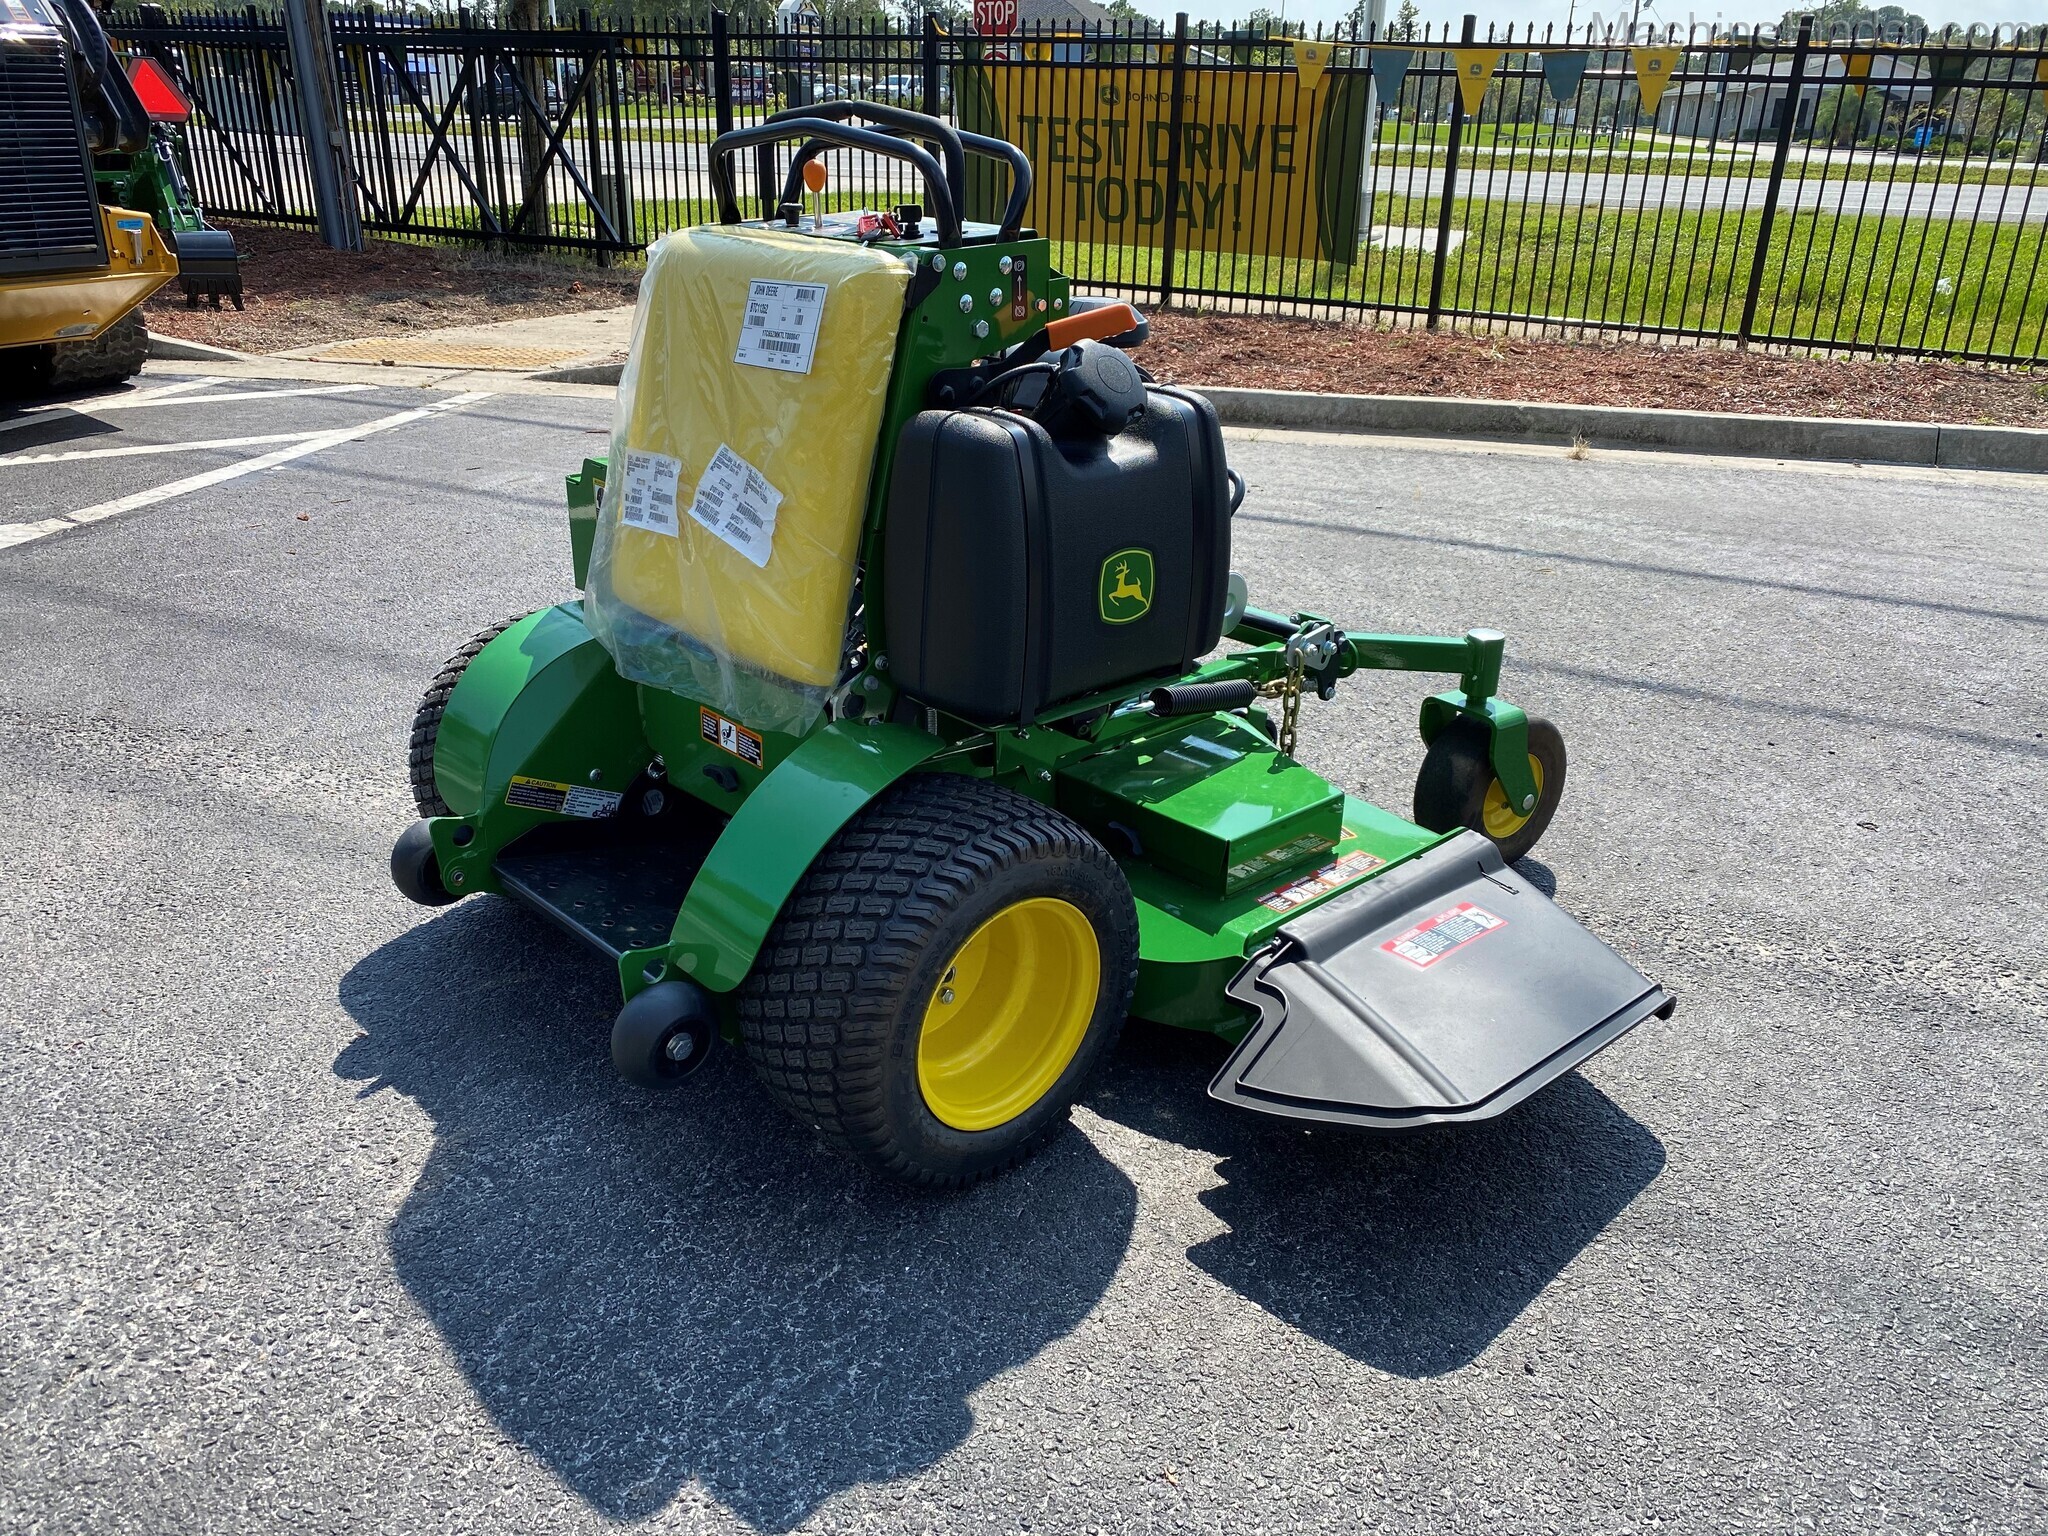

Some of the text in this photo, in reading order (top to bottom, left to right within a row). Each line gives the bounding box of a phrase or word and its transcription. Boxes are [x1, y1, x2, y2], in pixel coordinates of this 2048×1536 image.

[977, 1, 1015, 25] STOP
[1017, 115, 1298, 174] TEST DRIVE
[1067, 174, 1242, 232] TODAY!
[754, 285, 779, 297] JOHN DEERE
[531, 780, 558, 789] CAUTION
